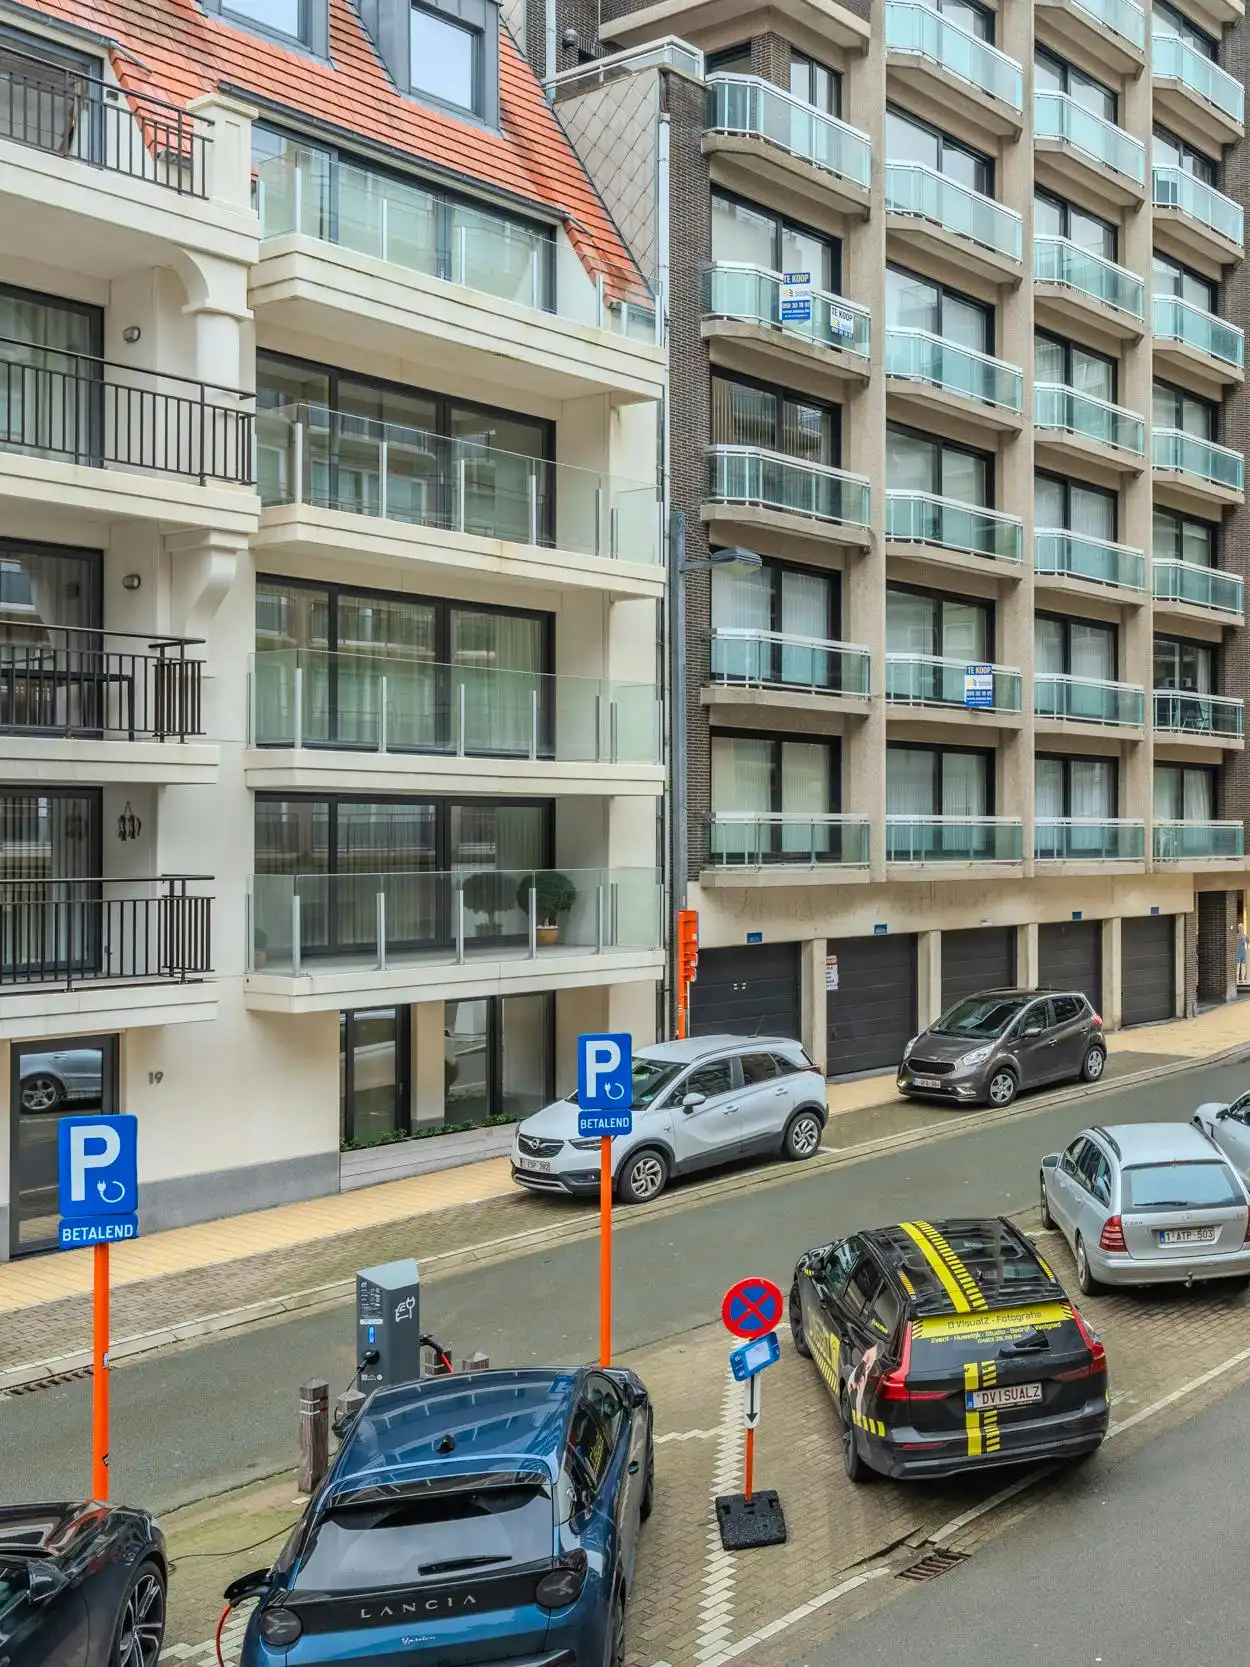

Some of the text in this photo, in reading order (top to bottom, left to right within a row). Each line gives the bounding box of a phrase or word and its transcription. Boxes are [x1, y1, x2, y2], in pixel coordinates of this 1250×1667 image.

[784, 274, 809, 283] TE KOOP
[832, 307, 852, 321] TE KOOP
[968, 666, 991, 674] TE KOOP
[148, 1071, 164, 1085] 19
[580, 1117, 630, 1129] BETALEND
[62, 1223, 134, 1242] BETALEND
[930, 1336, 949, 1344] Event
[985, 1329, 1005, 1337] Studio
[982, 1385, 1040, 1404] DVISUALZ
[361, 1594, 476, 1618] LANCIA
